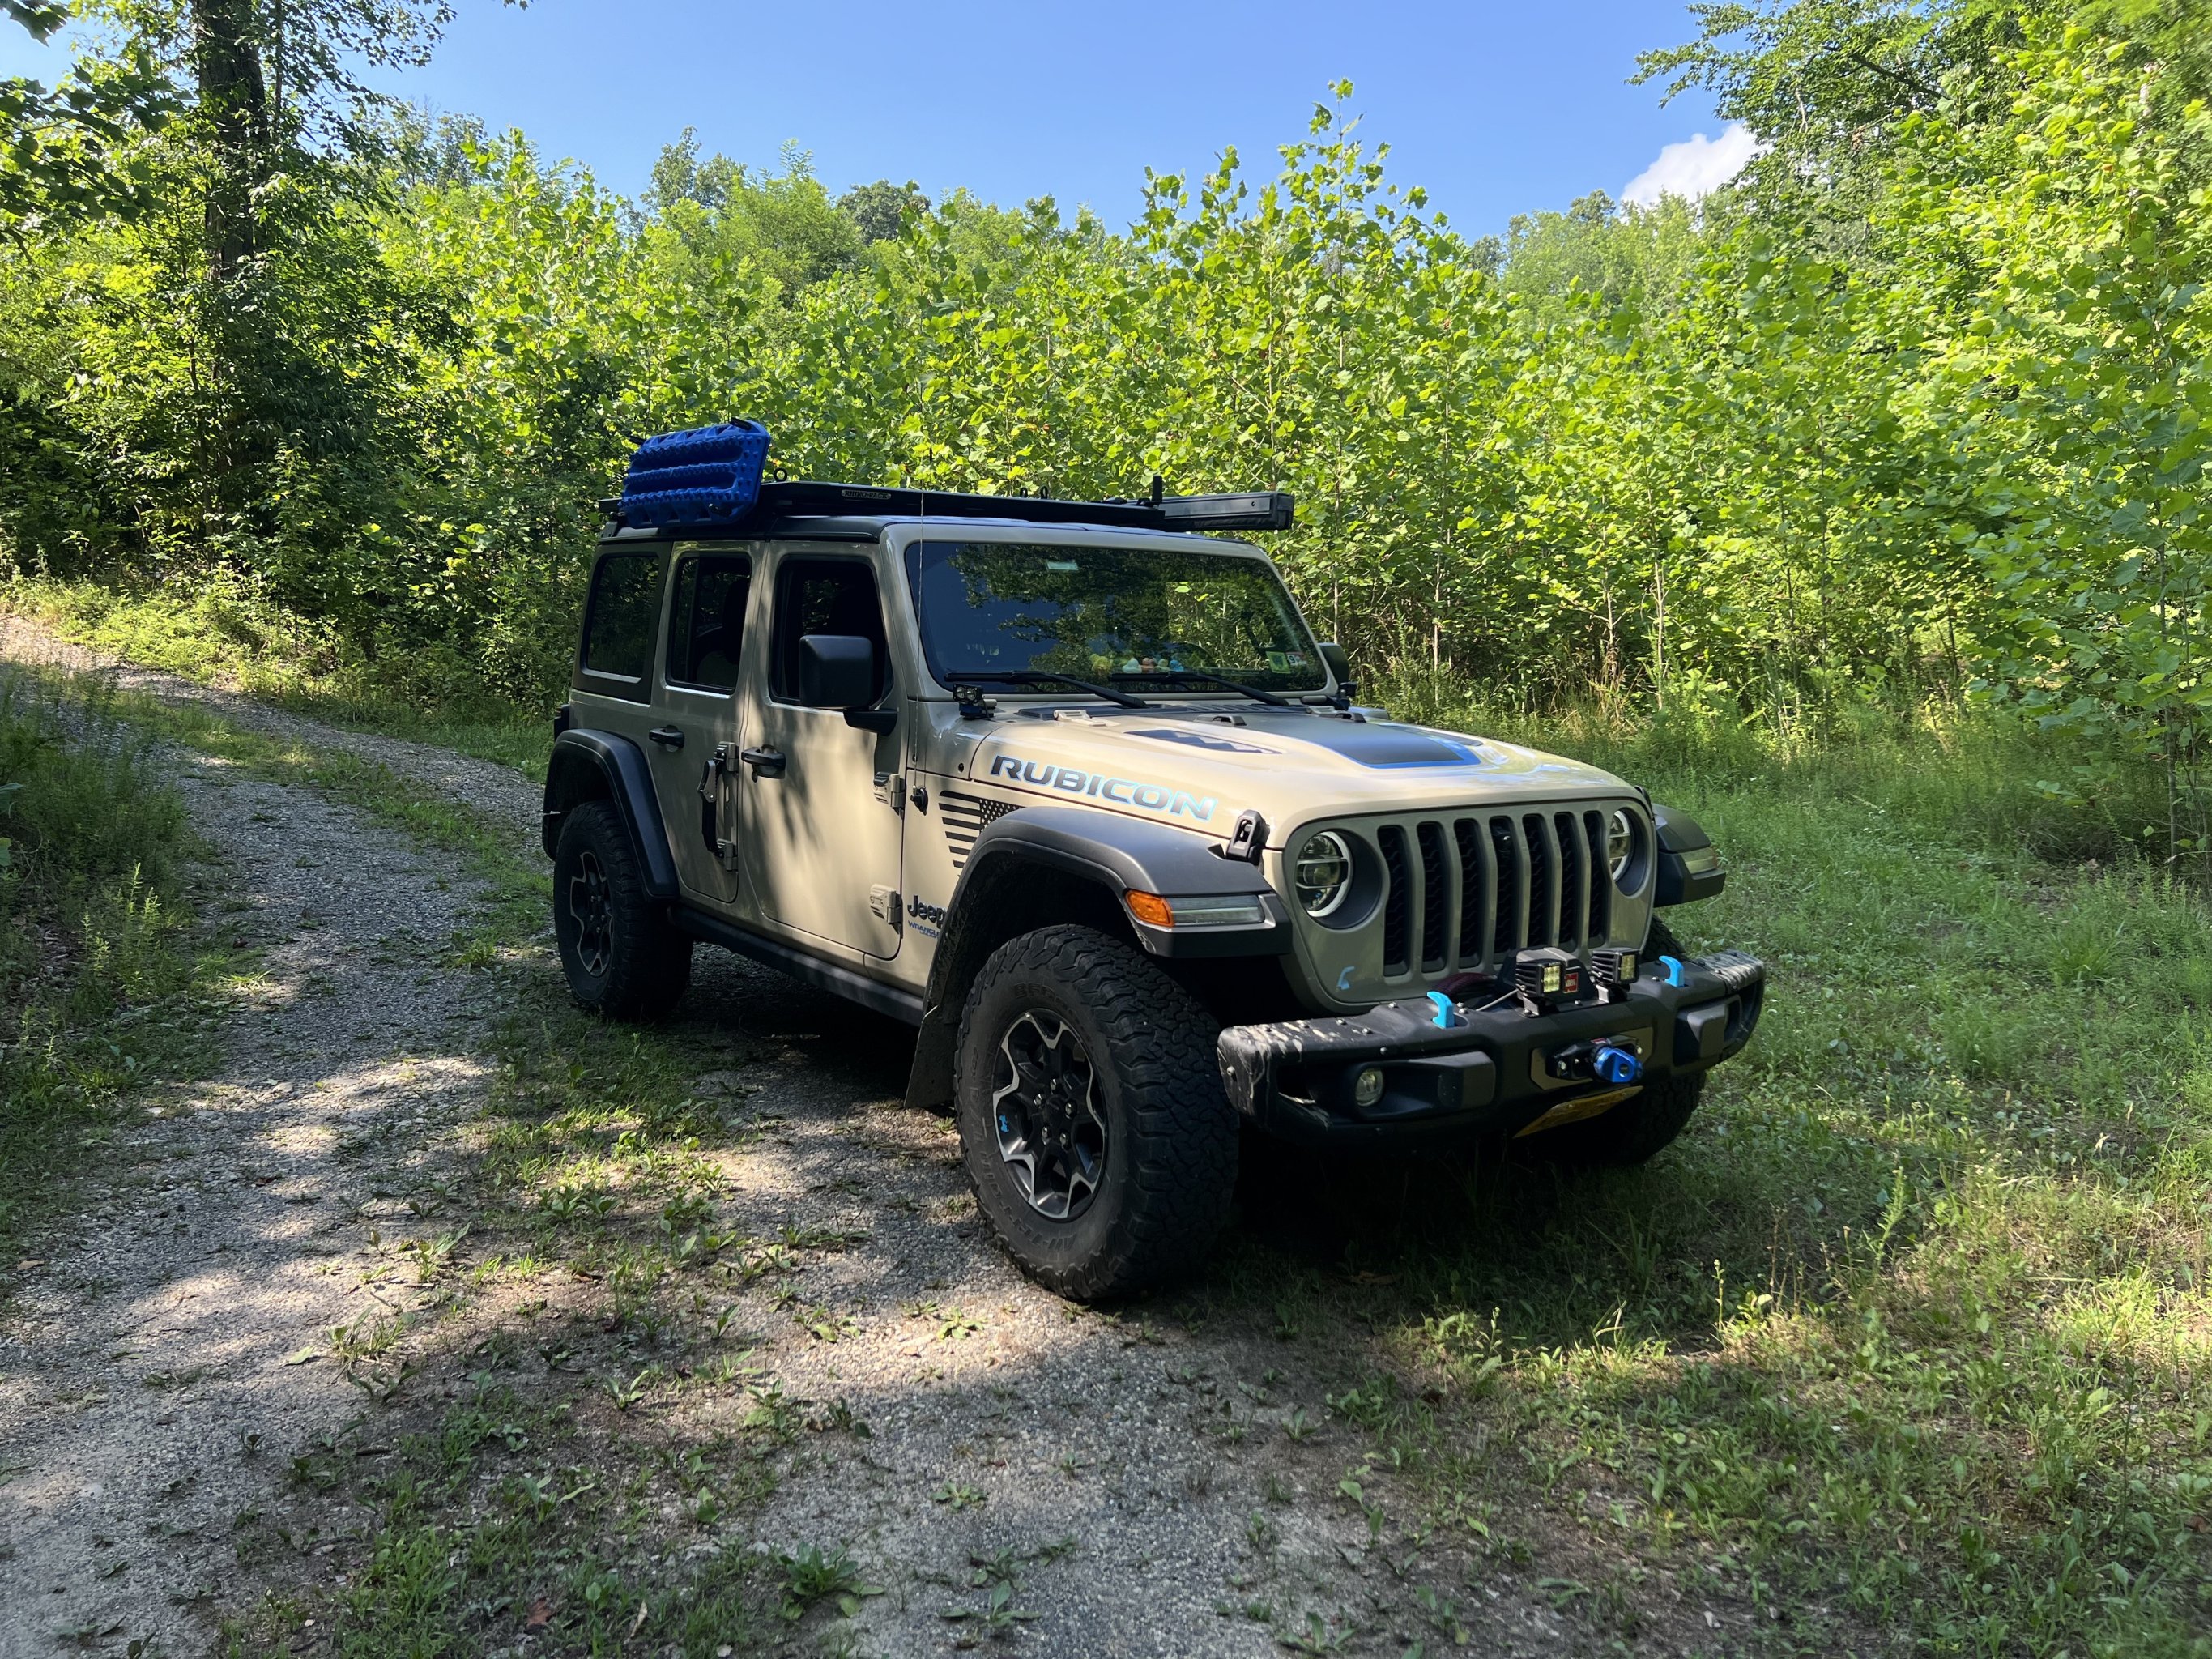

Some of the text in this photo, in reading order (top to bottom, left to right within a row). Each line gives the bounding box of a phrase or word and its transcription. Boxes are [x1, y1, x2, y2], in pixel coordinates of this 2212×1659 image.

[845, 490, 888, 499] RHINO-RACK
[990, 754, 1217, 821] RUBICON
[907, 895, 947, 929] Jeep
